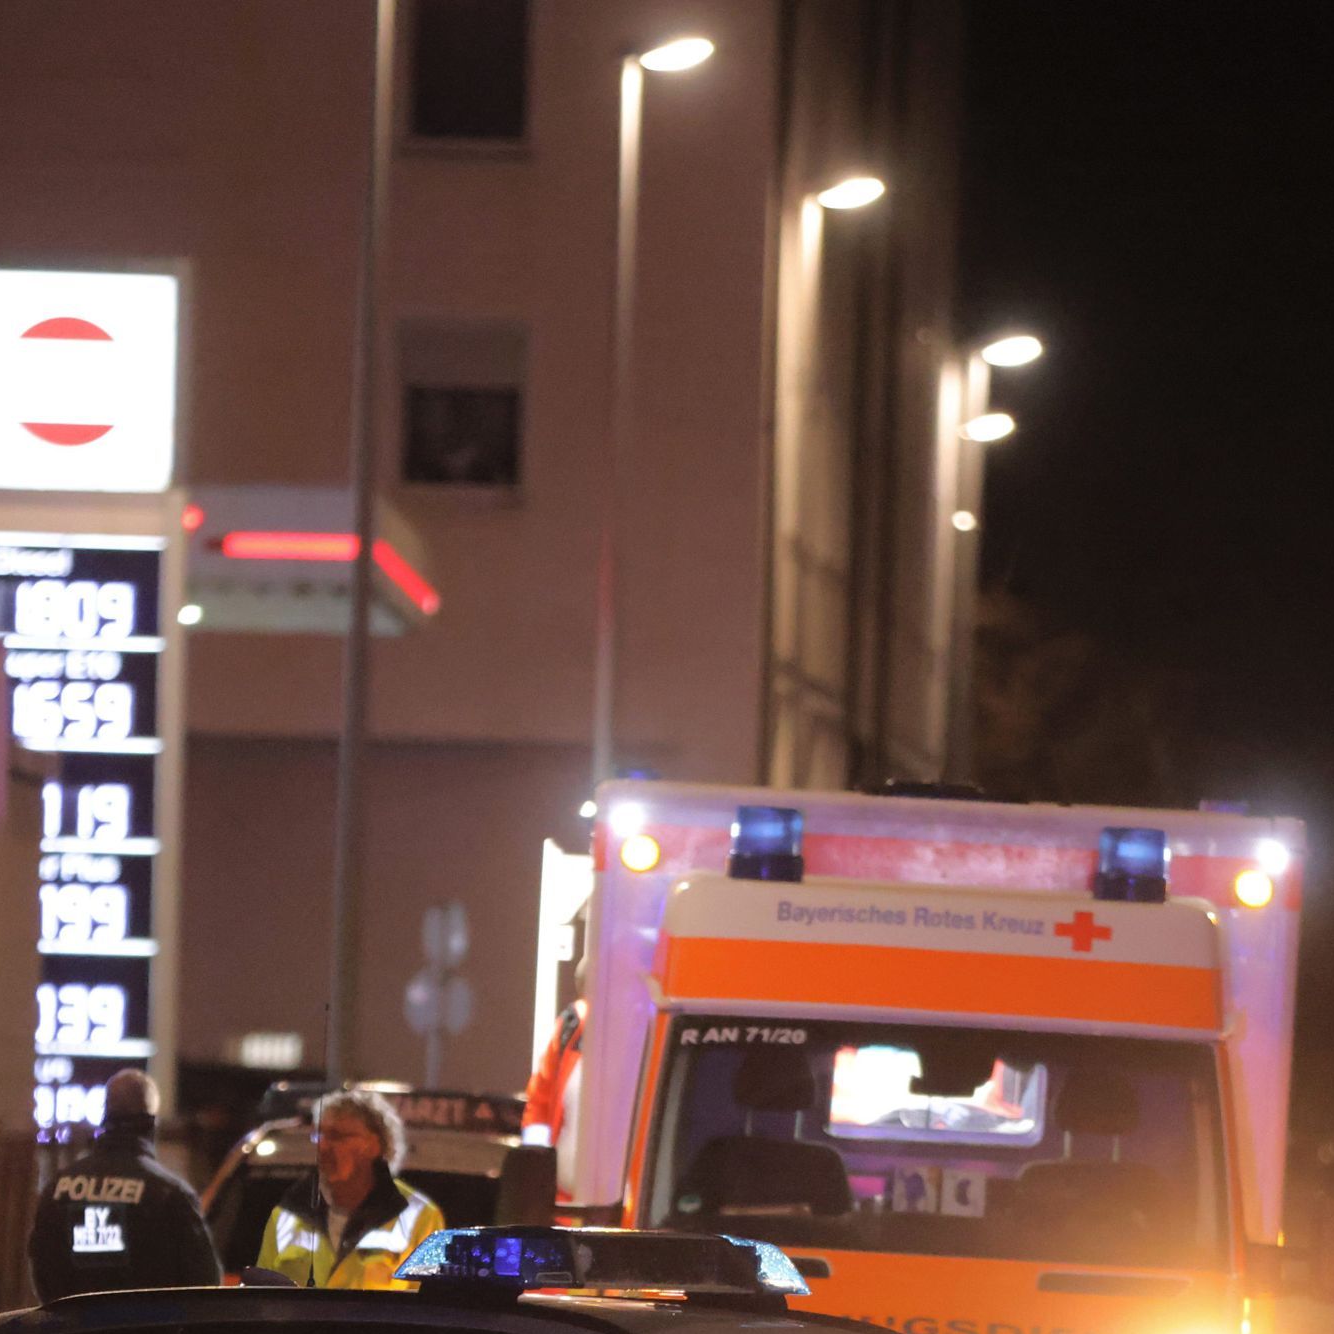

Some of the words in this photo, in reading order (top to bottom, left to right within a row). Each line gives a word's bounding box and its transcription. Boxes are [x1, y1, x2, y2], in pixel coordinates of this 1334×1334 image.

[776, 901, 907, 926] Bayerisches
[914, 907, 977, 931] Rotes
[982, 911, 1045, 936] Kreuz
[746, 1026, 807, 1045] 71/20
[53, 1175, 145, 1204] POLIZEI
